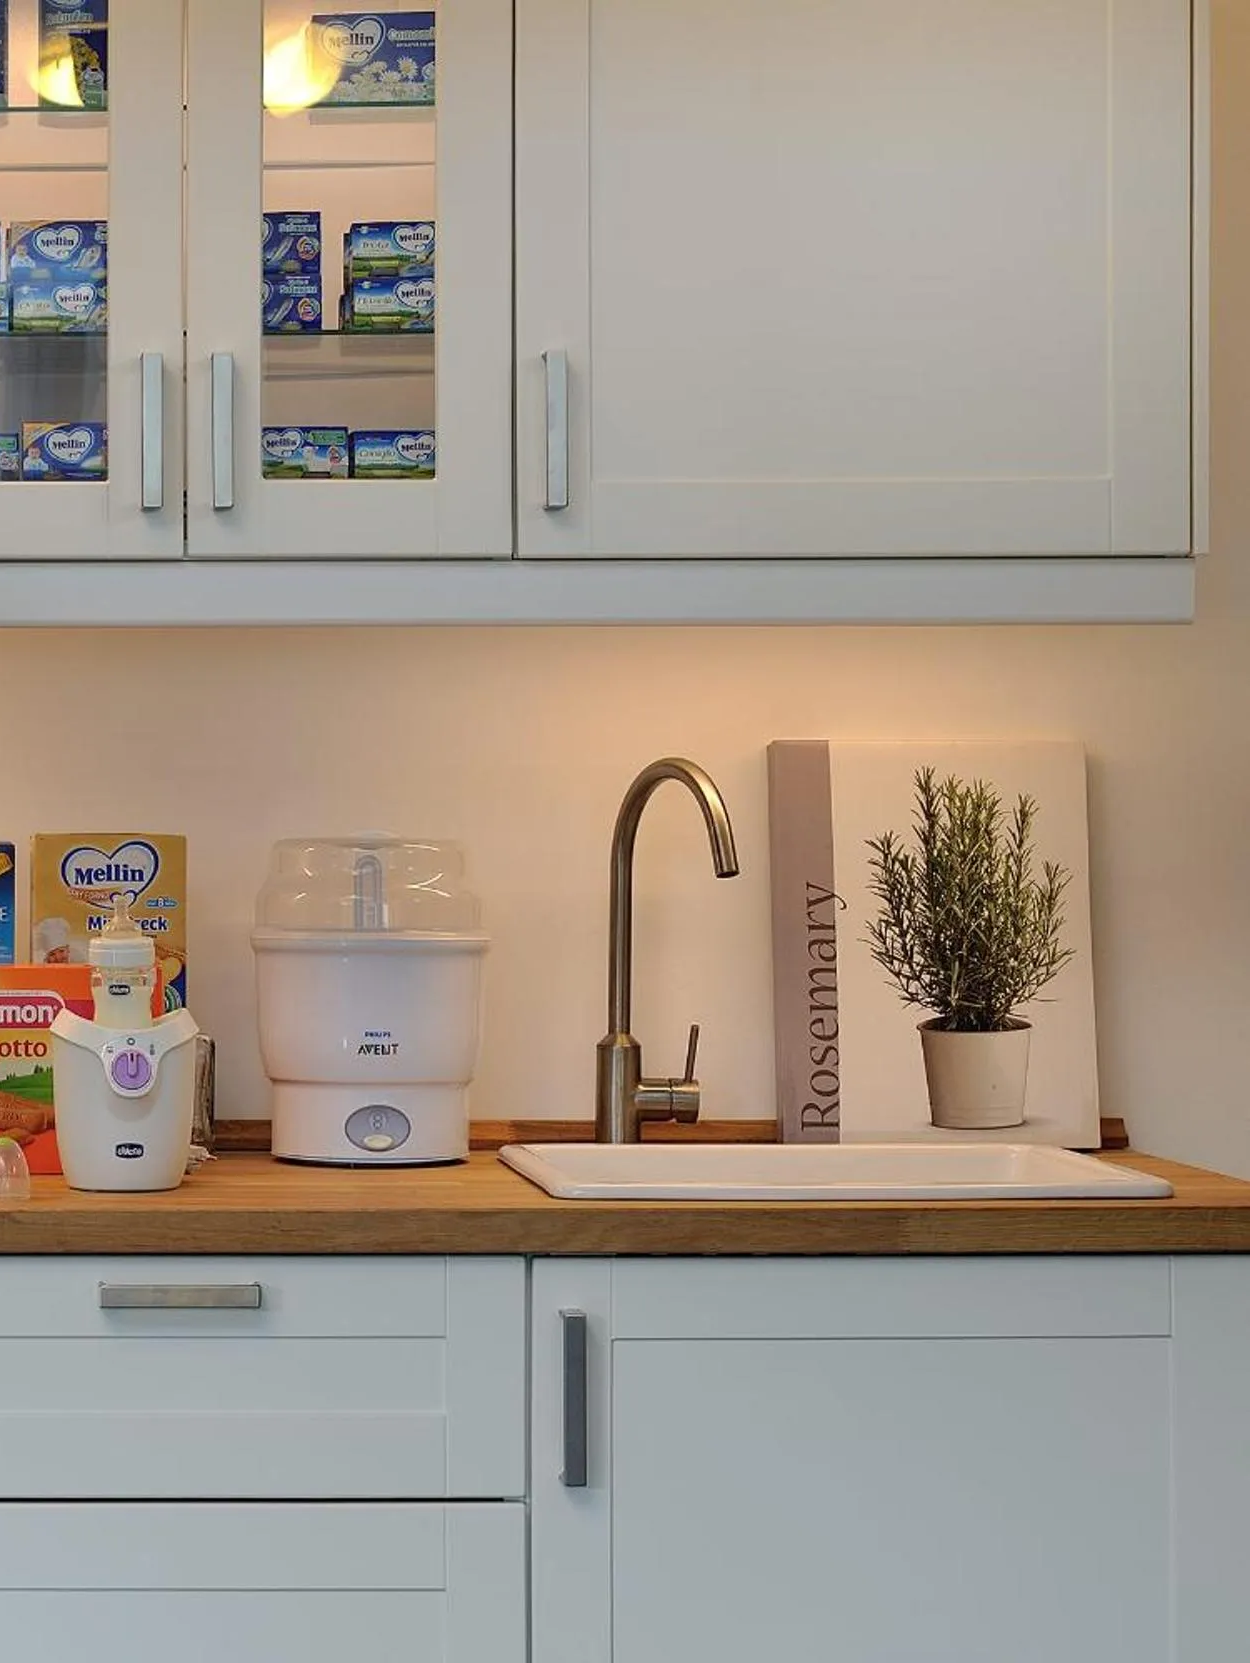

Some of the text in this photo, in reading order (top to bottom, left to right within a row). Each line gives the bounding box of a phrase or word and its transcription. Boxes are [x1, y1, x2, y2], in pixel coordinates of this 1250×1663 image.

[329, 33, 374, 48] Mellin
[40, 236, 74, 247] Mellin
[399, 232, 430, 242] Mellin
[59, 293, 90, 303] Mellin
[401, 287, 432, 298] Mellin
[52, 439, 86, 450] Mellin
[266, 437, 297, 448] Mellin
[401, 442, 432, 453] Mellin
[74, 864, 145, 886] Mellin
[800, 881, 848, 1131] Rosemary
